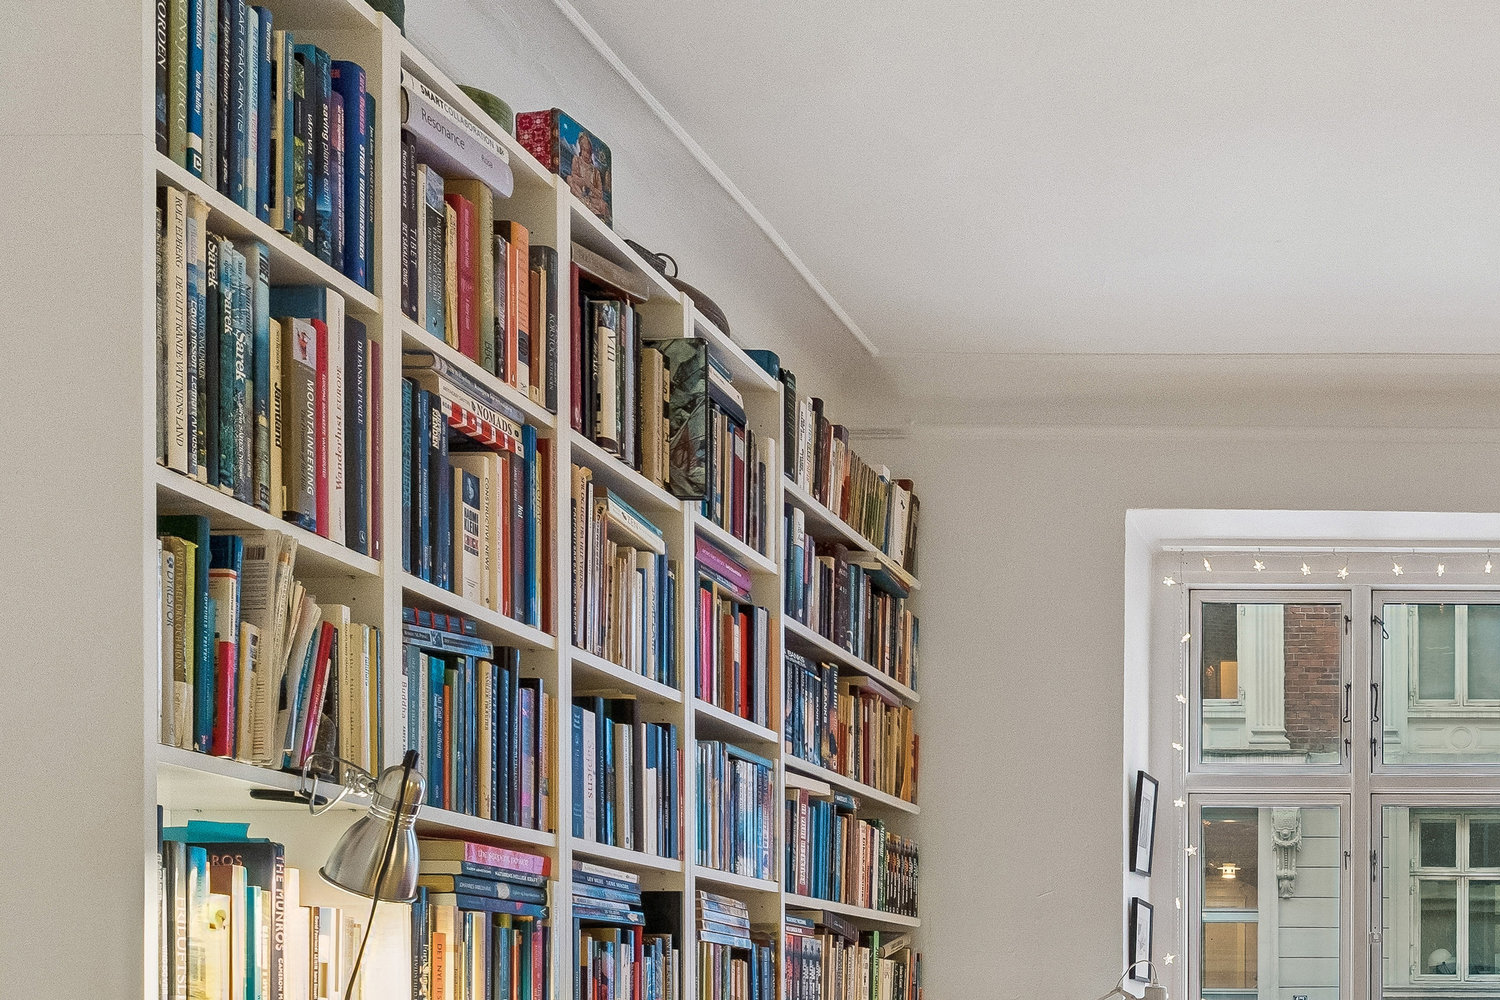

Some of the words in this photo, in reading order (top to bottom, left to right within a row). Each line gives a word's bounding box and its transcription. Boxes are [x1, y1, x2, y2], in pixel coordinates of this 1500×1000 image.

[321, 103, 329, 140] saving
[421, 108, 466, 150] Resonance
[484, 341, 492, 364] BBC
[477, 405, 512, 435] NOMADS
[306, 379, 314, 496] MOUNTAINEERING
[436, 965, 444, 982] NYE
